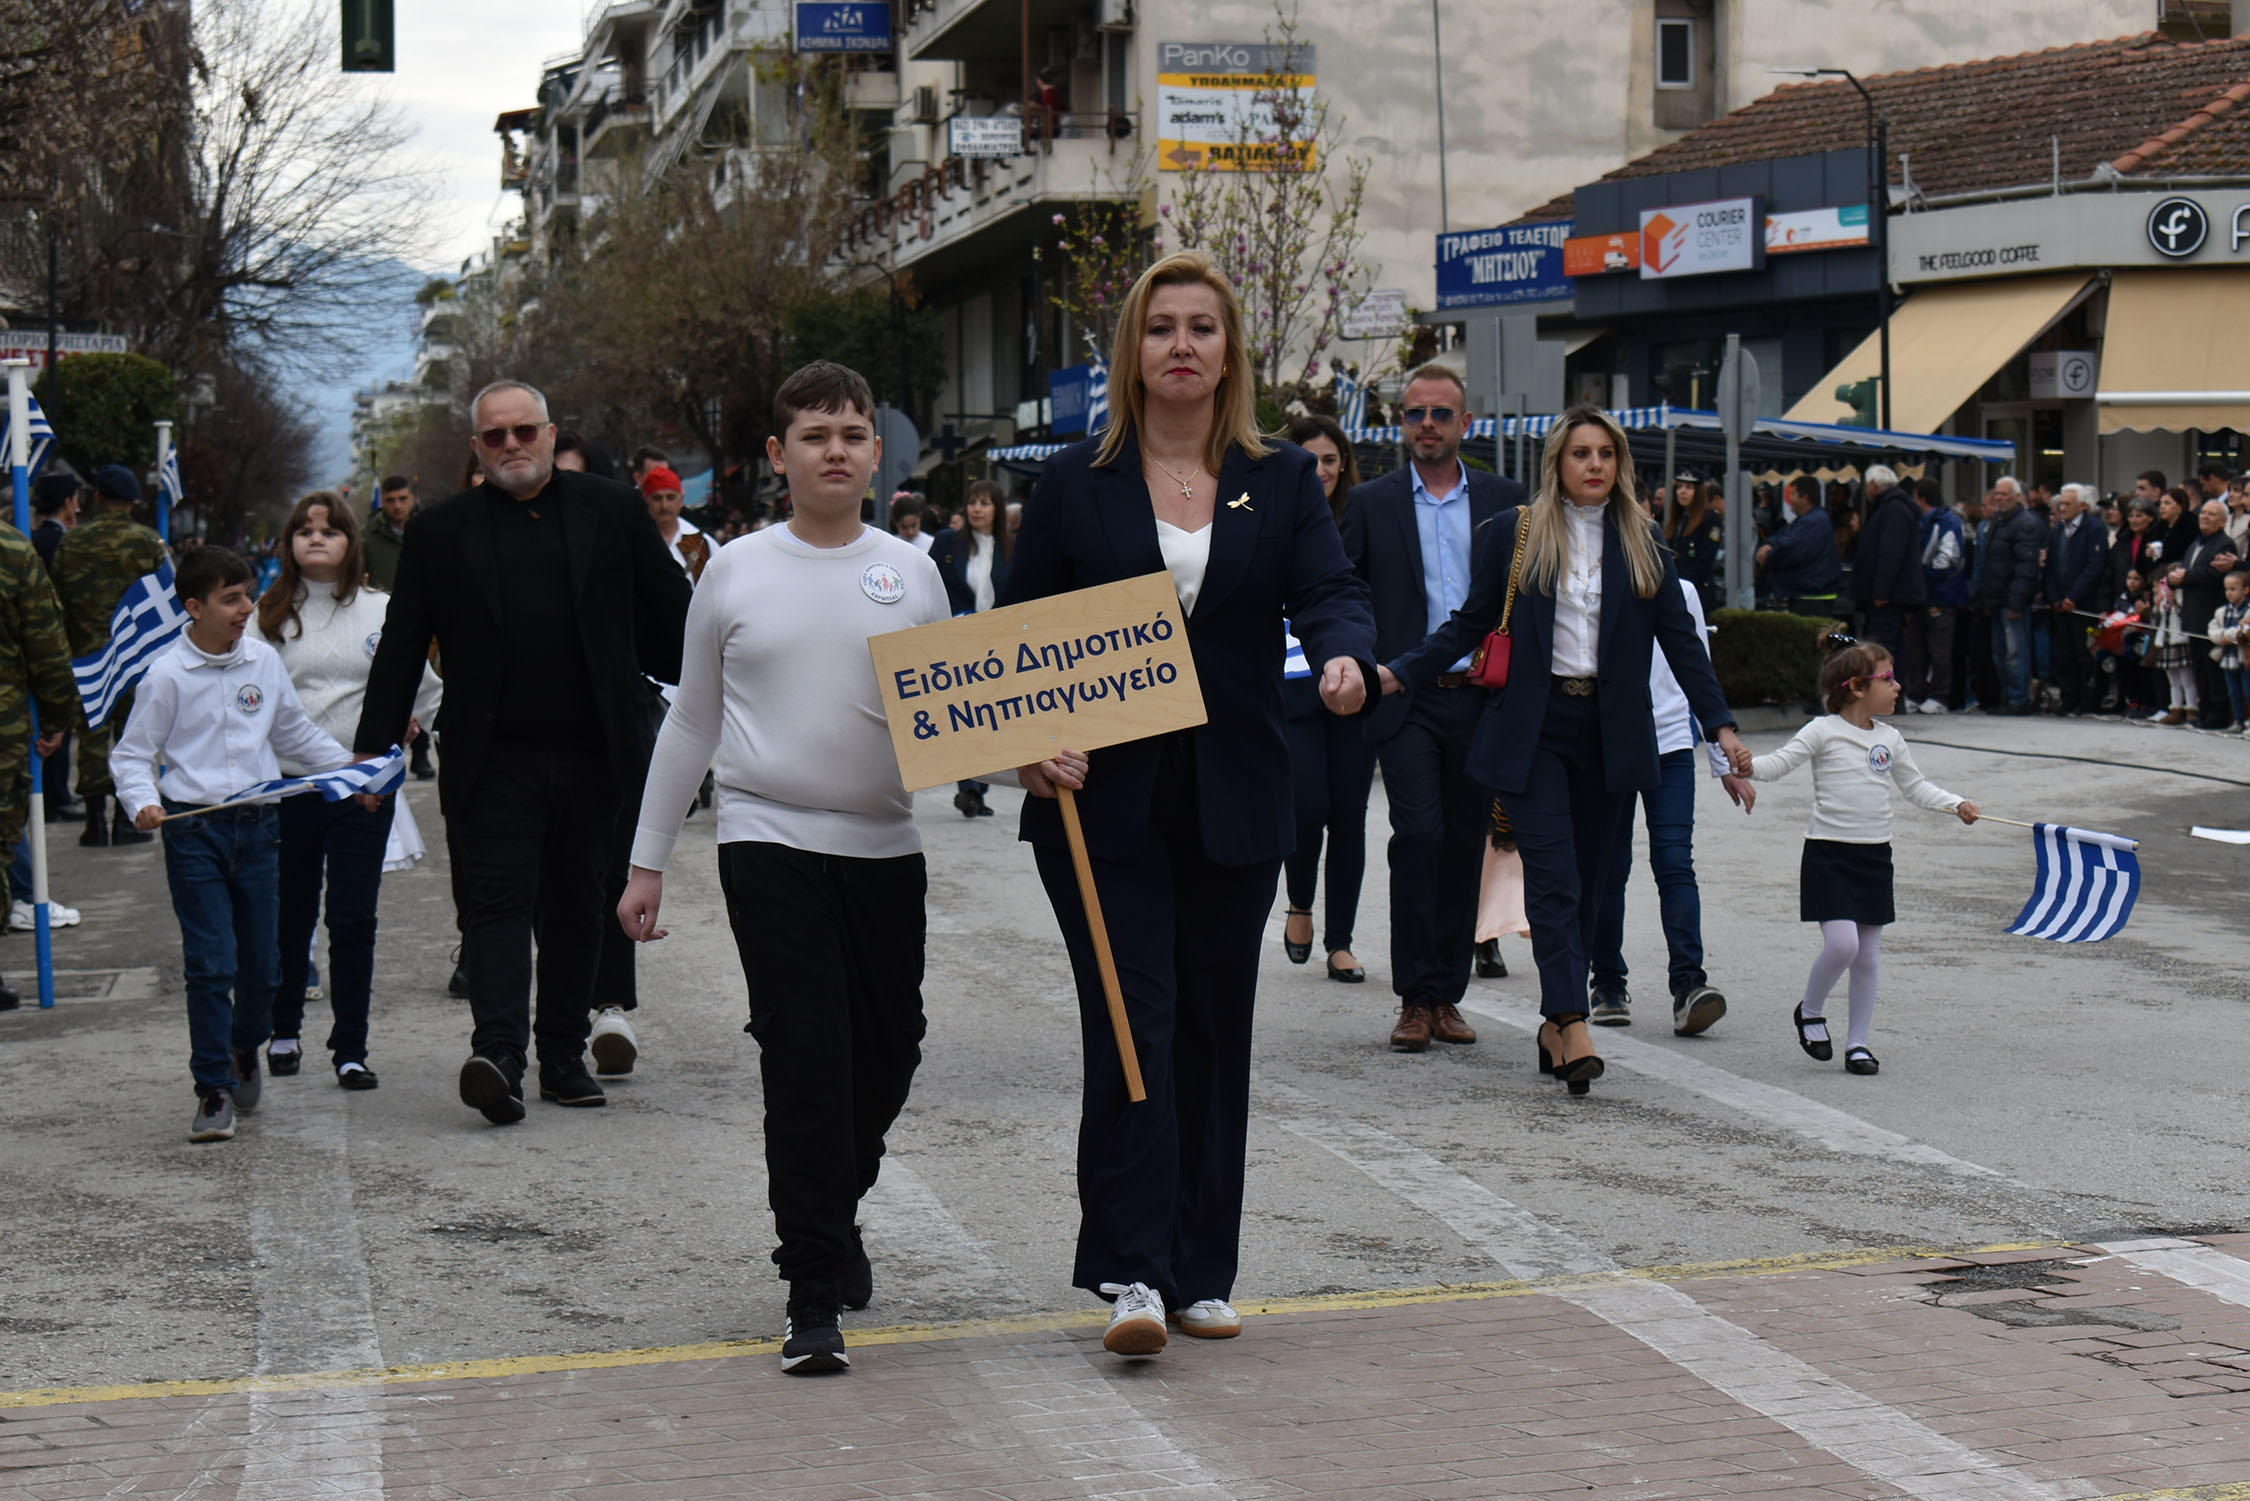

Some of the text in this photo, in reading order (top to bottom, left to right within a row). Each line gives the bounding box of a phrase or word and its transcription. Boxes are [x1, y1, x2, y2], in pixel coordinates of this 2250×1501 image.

[1164, 44, 1250, 67] PanKo
[1170, 111, 1226, 124] adam's
[1697, 208, 1745, 228] COURIER
[1444, 225, 1570, 262] ΓΡΑΦΕΙΟ ΤΕΛΕΤΩΝ
[1697, 228, 1742, 248] CENTER
[1918, 244, 2040, 271] THE FEELGOOD COFFEE
[894, 612, 1173, 699] Ειδικό Δημοτικό
[913, 658, 1178, 740] & Νηπιαγωγείο
